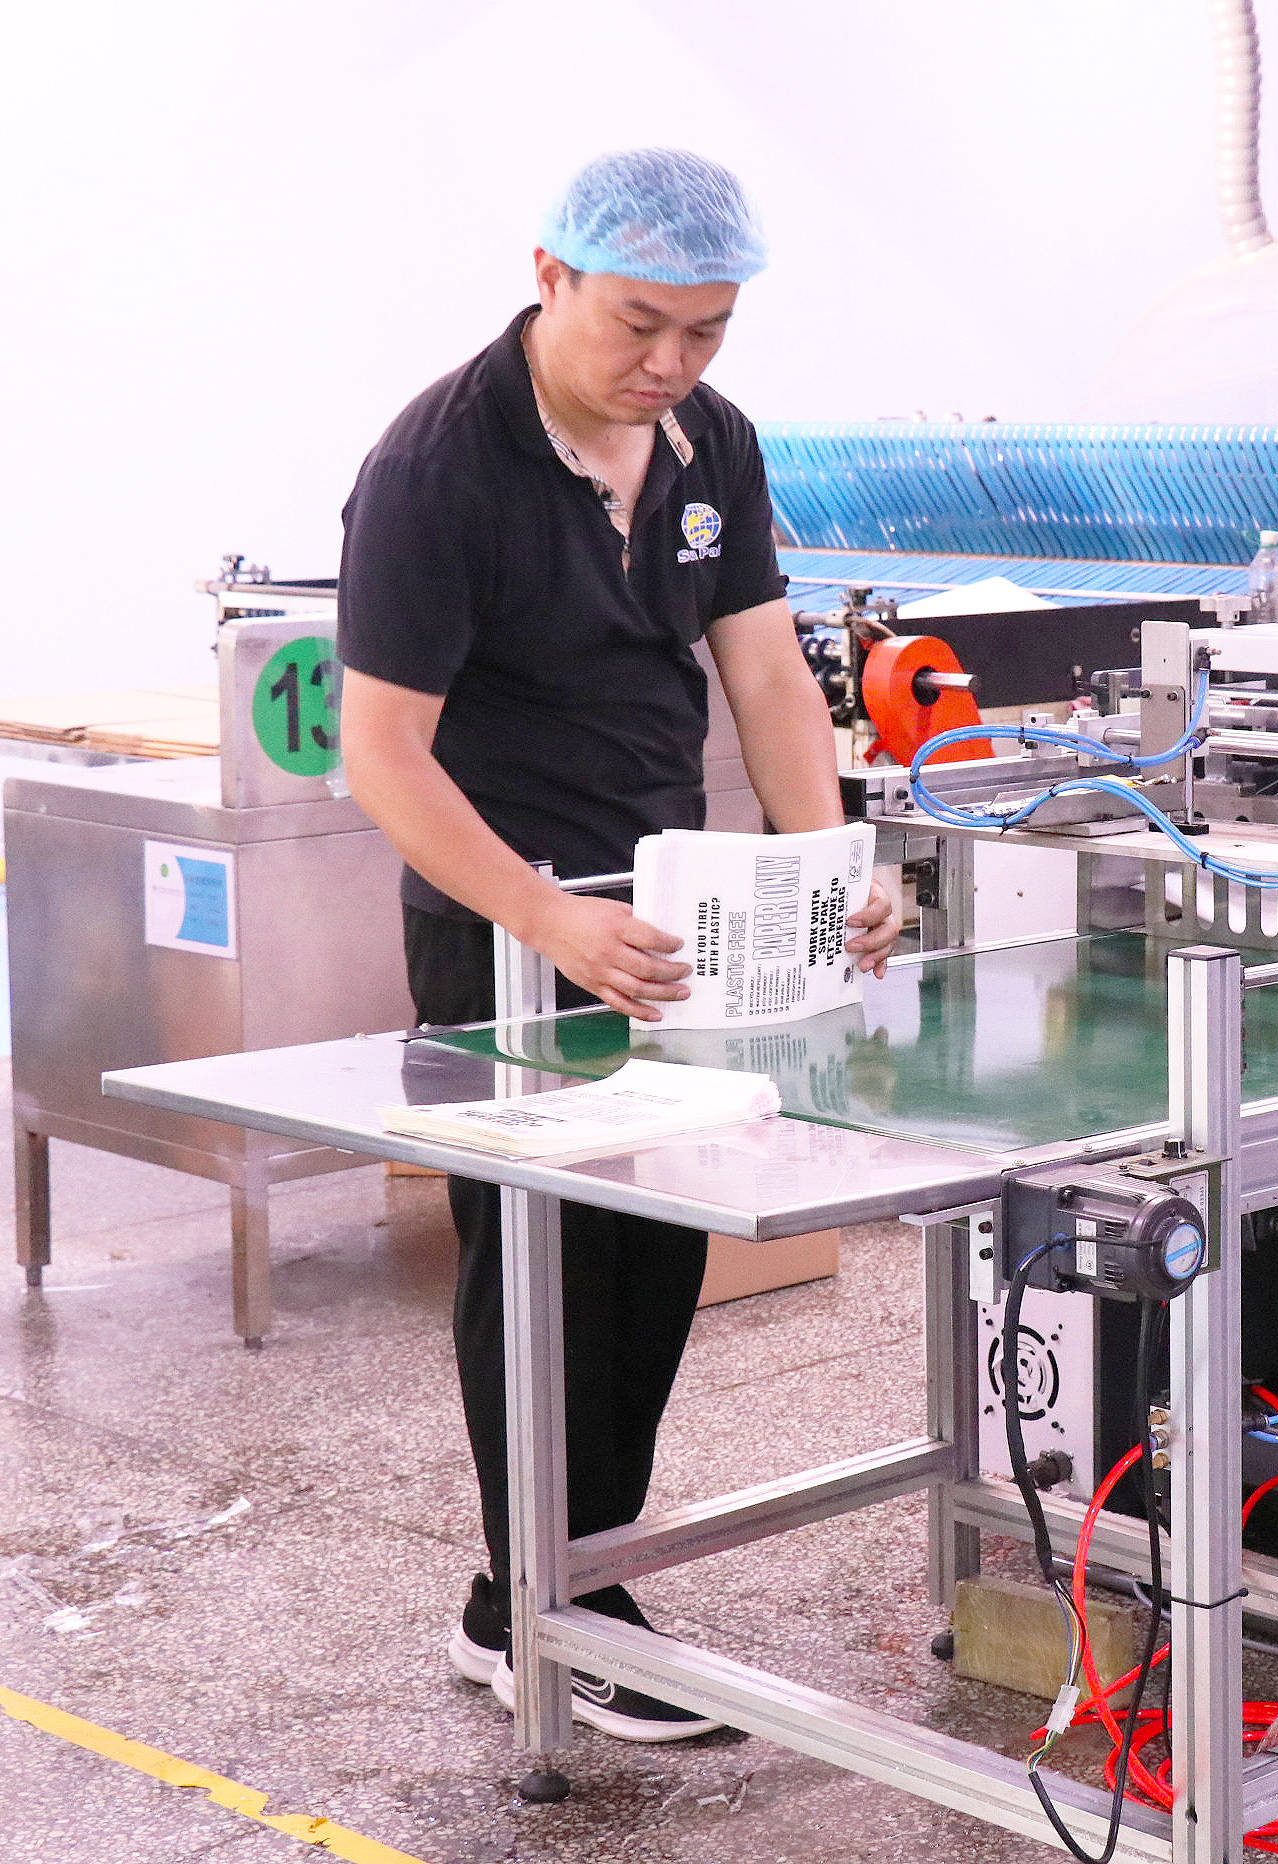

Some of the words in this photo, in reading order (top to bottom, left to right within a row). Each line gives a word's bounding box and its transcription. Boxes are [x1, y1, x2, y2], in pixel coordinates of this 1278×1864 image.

[270, 660, 341, 752] 13
[754, 855, 801, 899] ONLY
[830, 877, 839, 894] TO
[698, 902, 708, 930] TIRED
[811, 889, 820, 925] WITH
[828, 895, 838, 931] MOVE
[837, 886, 846, 914] BAG
[710, 897, 720, 946] PLASTIC?
[728, 912, 747, 951] FREE
[752, 900, 798, 961] PAPER
[835, 915, 844, 955] PAPER
[697, 935, 707, 954] YOU
[808, 926, 818, 967] WORK
[818, 927, 827, 954] SUN
[826, 934, 835, 967] LET'S
[697, 958, 706, 976] ARE
[709, 950, 719, 977] WITH
[725, 953, 745, 1018] PLASTIC
